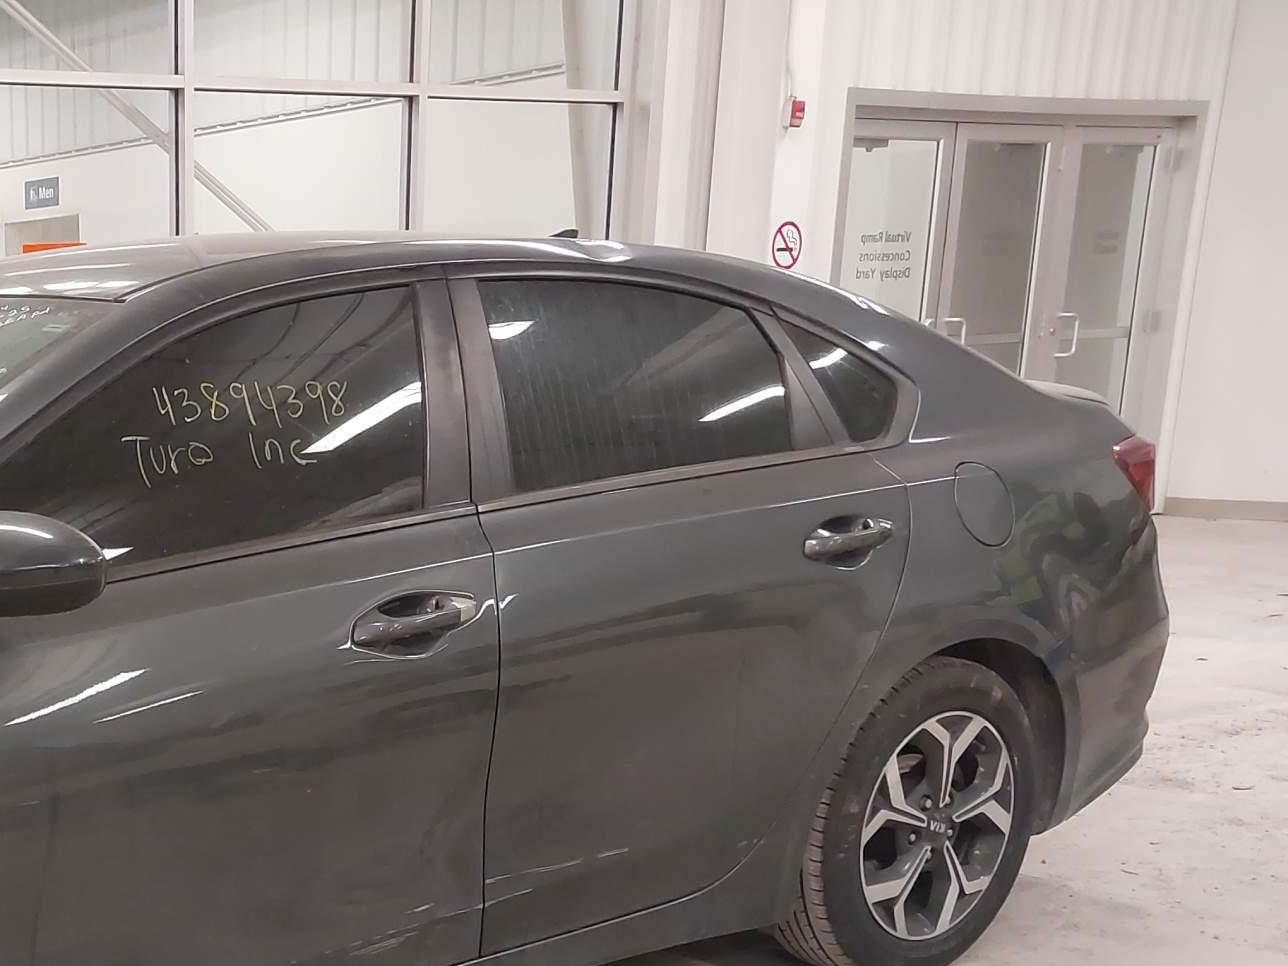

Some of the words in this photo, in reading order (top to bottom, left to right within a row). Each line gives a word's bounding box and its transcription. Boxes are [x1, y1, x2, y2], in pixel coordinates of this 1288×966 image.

[38, 186, 54, 200] Men
[152, 380, 348, 429] 43894398
[120, 435, 215, 489] Turo
[247, 431, 318, 469] Inc
